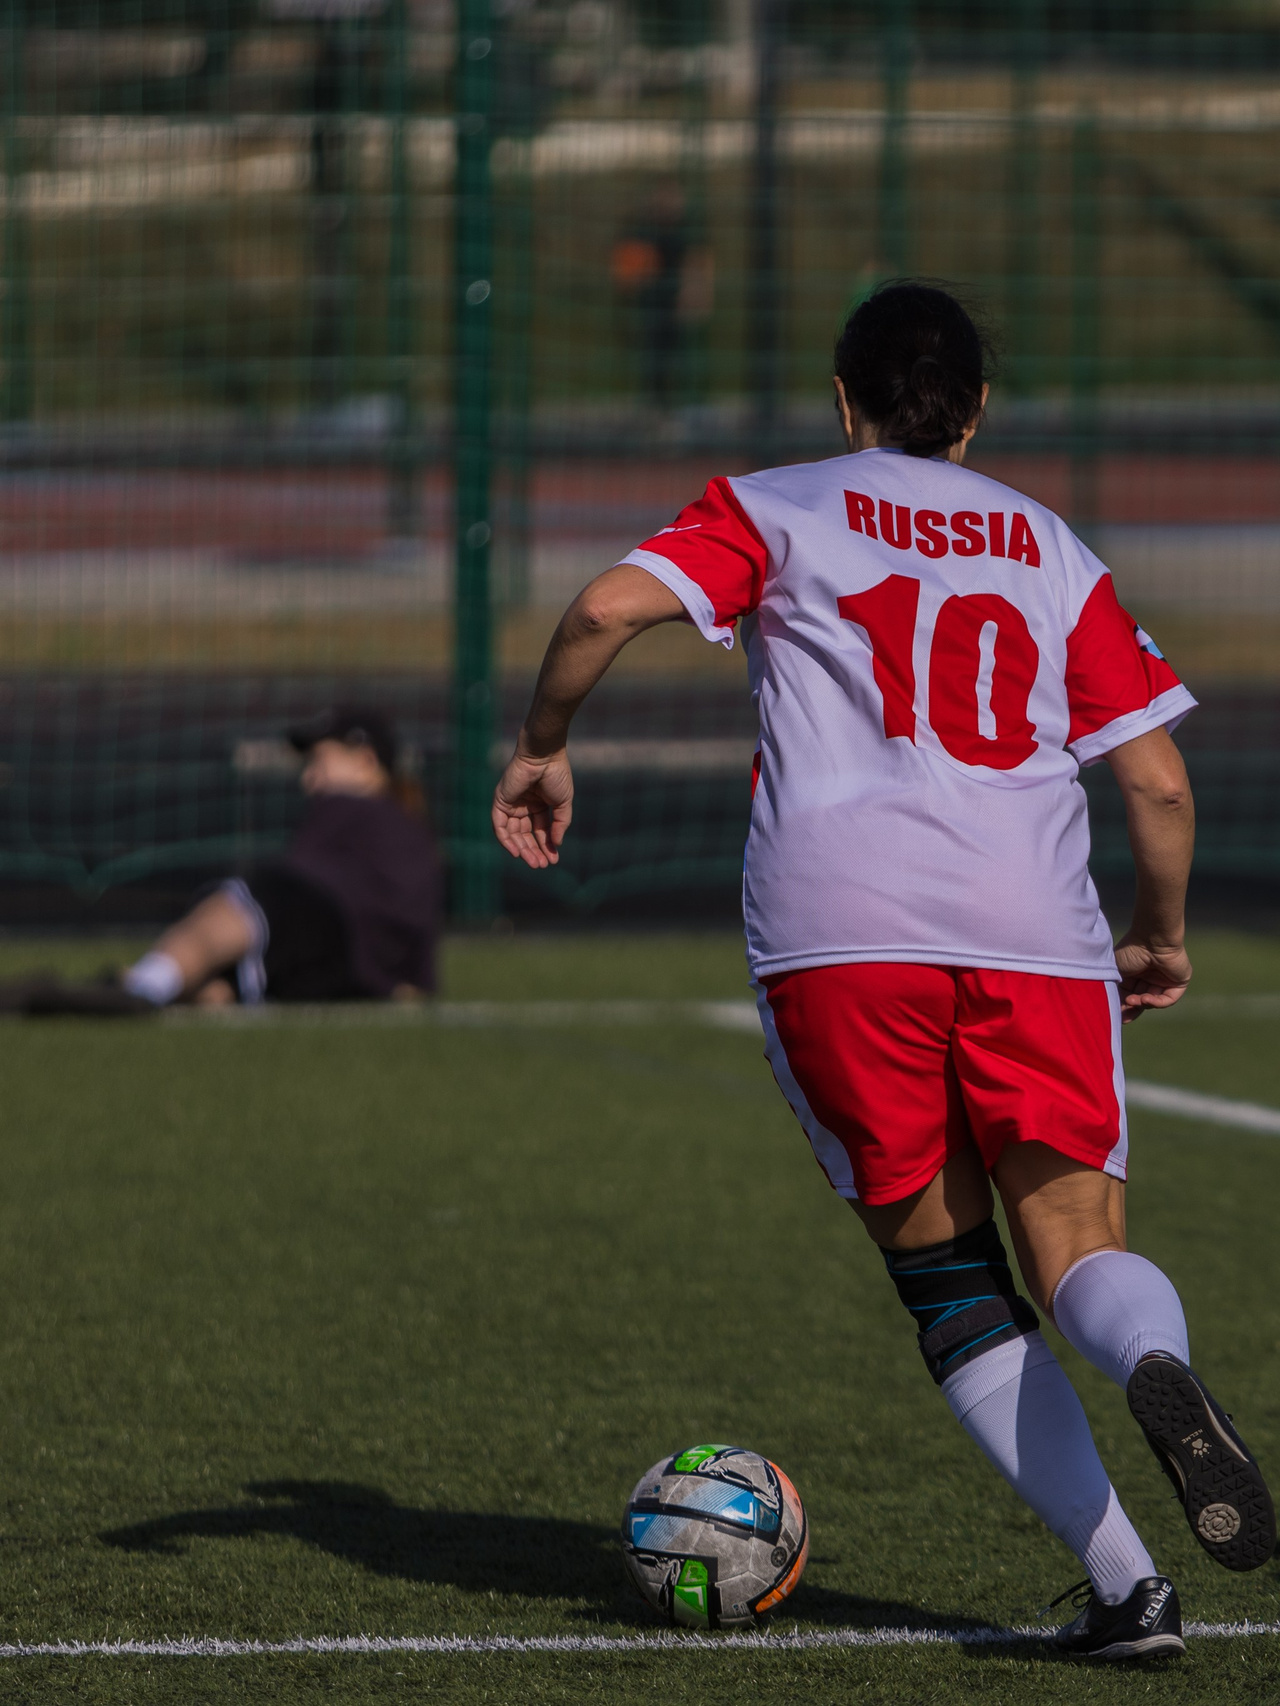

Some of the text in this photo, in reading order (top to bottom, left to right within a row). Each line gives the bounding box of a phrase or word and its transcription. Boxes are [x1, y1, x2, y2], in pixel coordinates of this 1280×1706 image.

[843, 489, 1041, 568] RUSSIA
[836, 573, 1040, 771] 10
[1138, 1582, 1172, 1627] KELME
